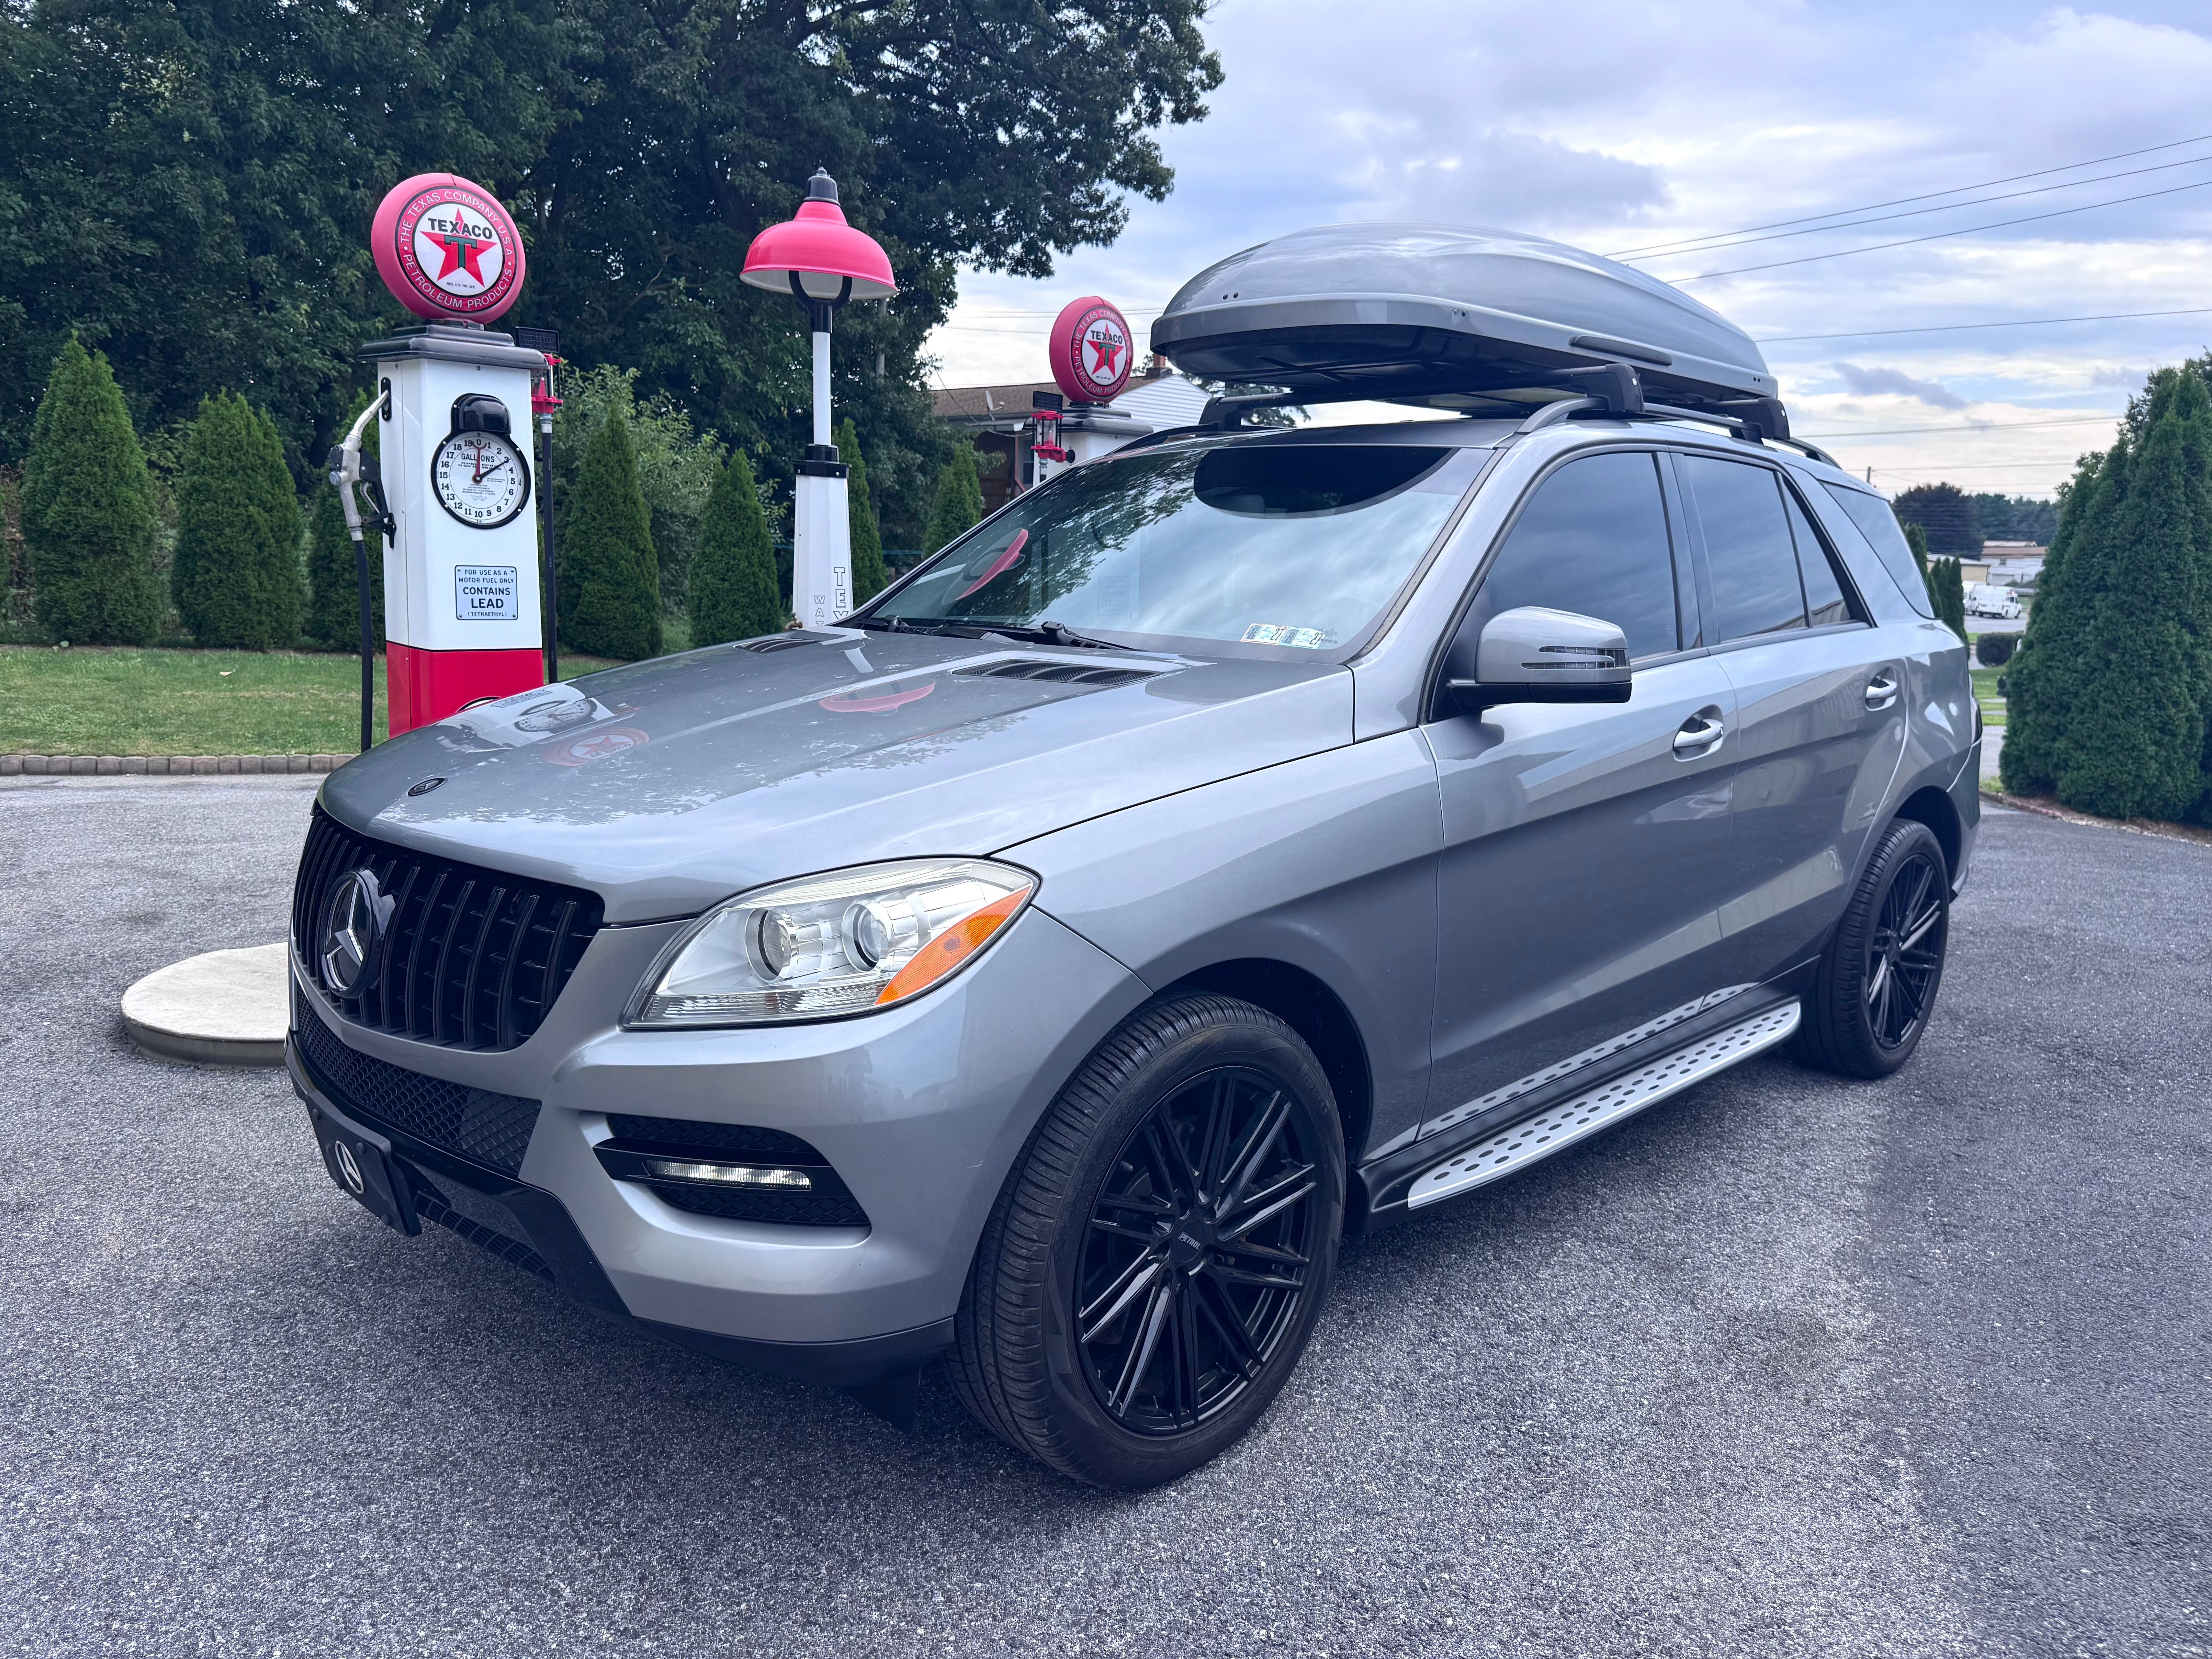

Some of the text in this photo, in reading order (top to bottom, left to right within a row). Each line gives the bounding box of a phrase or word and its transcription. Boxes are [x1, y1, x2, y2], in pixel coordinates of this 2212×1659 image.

[400, 219, 413, 243] THE
[407, 193, 440, 216] TEXAS
[444, 191, 499, 222] COMPANY
[428, 218, 493, 239] TEXACO
[403, 254, 512, 309] PETROLEUM PRODUCTS
[1079, 312, 1097, 329] TEXAS
[1091, 330, 1123, 344] TEXACO
[1075, 357, 1103, 393] PETROLEUM
[461, 453, 495, 462] GALLONS
[463, 587, 510, 595] CONTAINS
[471, 598, 504, 608] LEAD
[1270, 628, 1284, 641] 27
[1309, 632, 1323, 645] 27
[1178, 1231, 1200, 1249] PETROL
